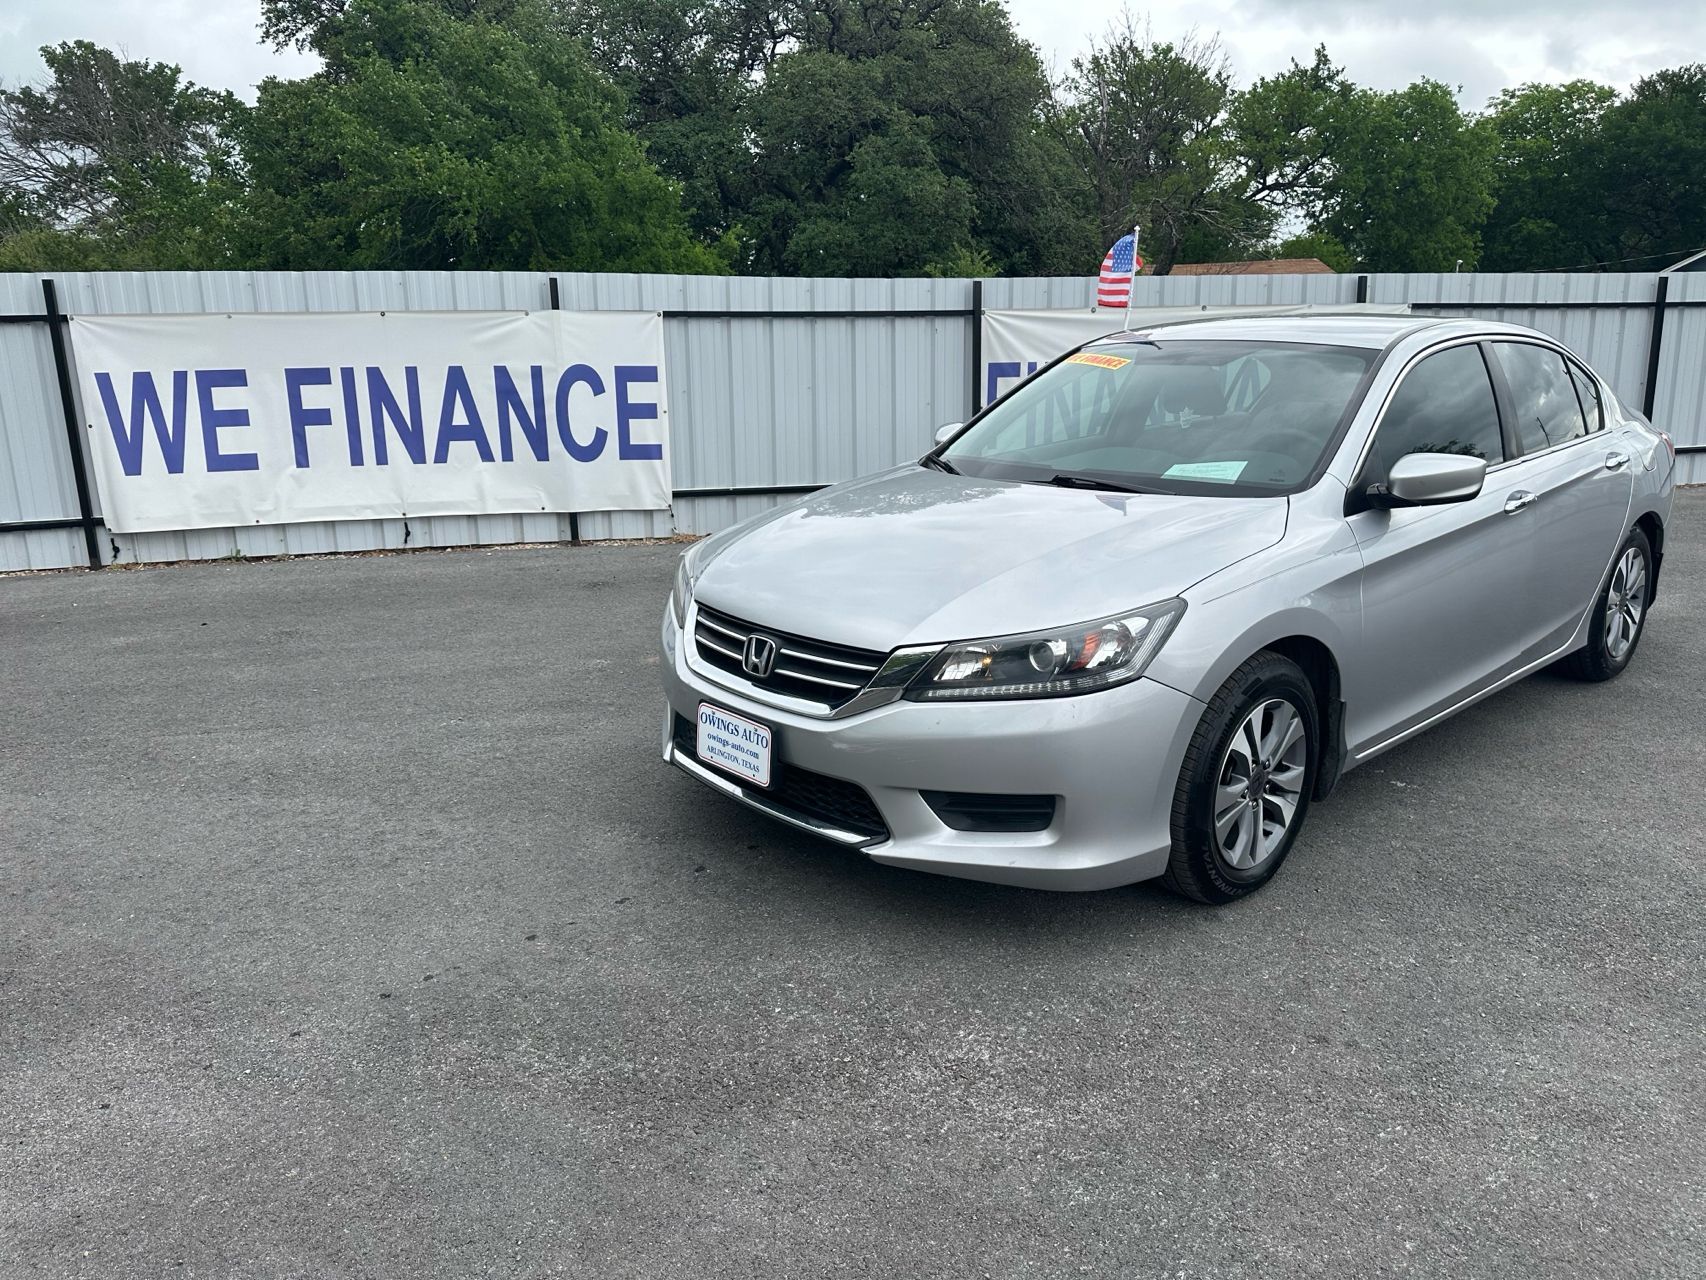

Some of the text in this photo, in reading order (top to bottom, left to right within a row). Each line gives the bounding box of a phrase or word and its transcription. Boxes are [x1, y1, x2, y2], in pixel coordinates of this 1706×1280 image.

[94, 363, 663, 477] WE FINANCE
[700, 711, 769, 749] OWINGS AUTO
[707, 732, 759, 760] owings-auto.com
[706, 744, 760, 773] ARLINGTON, TEXAS
[1201, 841, 1249, 897] NTINENTAL
